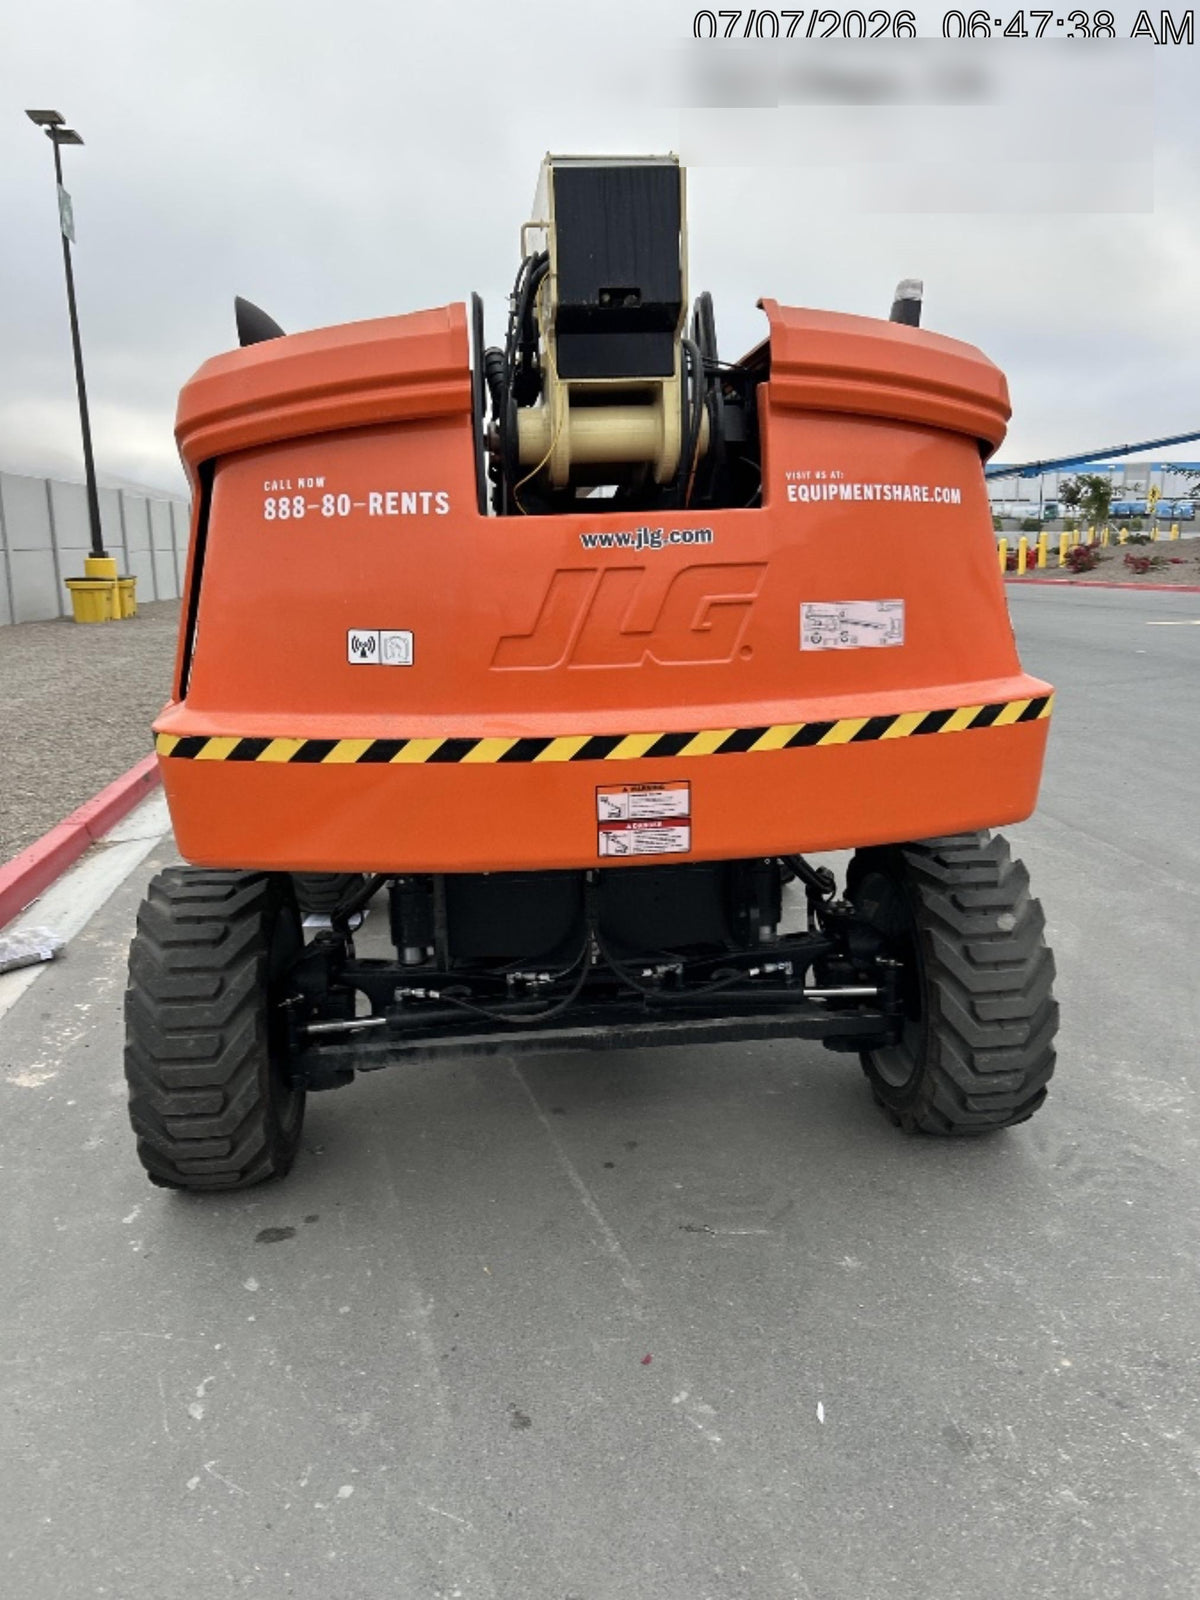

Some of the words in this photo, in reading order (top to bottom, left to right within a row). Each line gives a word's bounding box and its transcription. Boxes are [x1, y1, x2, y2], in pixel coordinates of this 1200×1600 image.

[264, 480, 293, 491] CALL
[298, 476, 326, 488] NOW
[785, 471, 811, 480] VISIT
[830, 471, 844, 479] AT:
[786, 483, 962, 504] EQUIPMENTSHARE.COM
[263, 491, 450, 520] 888-80-RENTS
[580, 527, 714, 550] www.jlg.com
